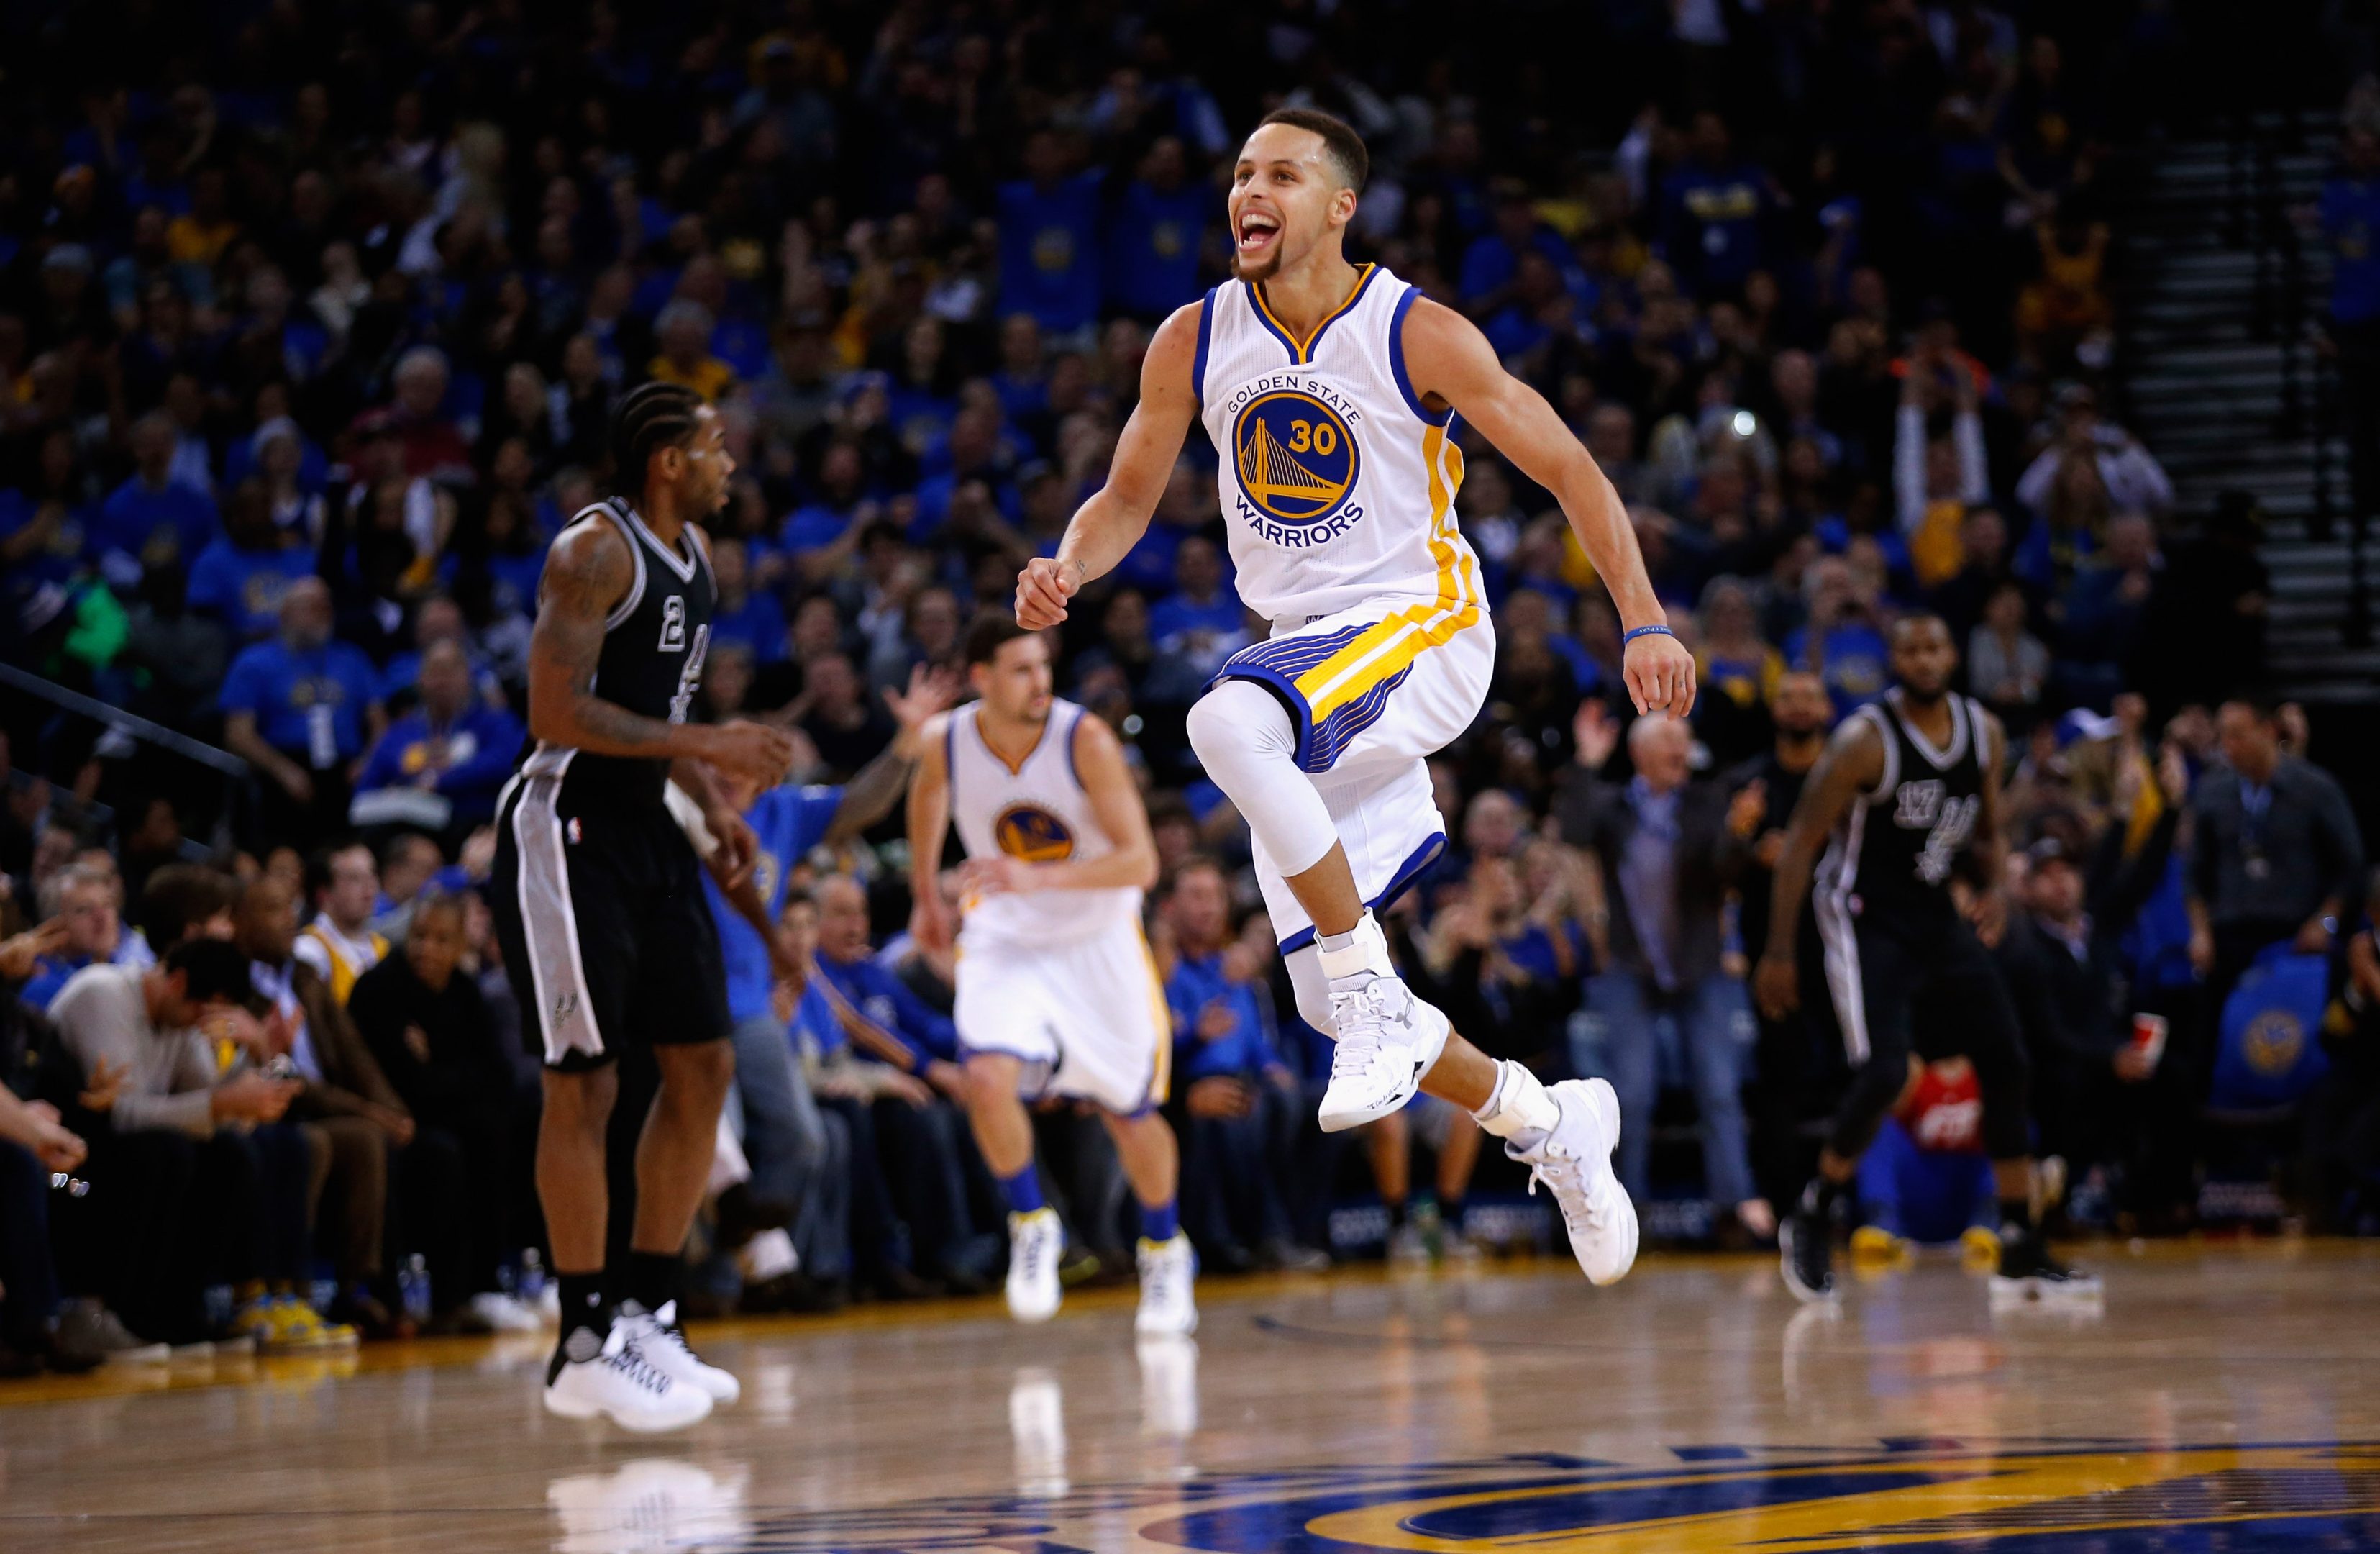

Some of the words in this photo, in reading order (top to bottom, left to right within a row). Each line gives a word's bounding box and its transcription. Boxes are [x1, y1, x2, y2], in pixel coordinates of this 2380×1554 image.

[1228, 376, 1298, 414] GOLDEN
[1306, 381, 1361, 425] STATE
[1288, 419, 1336, 455] 30
[1235, 492, 1364, 547] WARRIORS
[657, 594, 686, 652] 2
